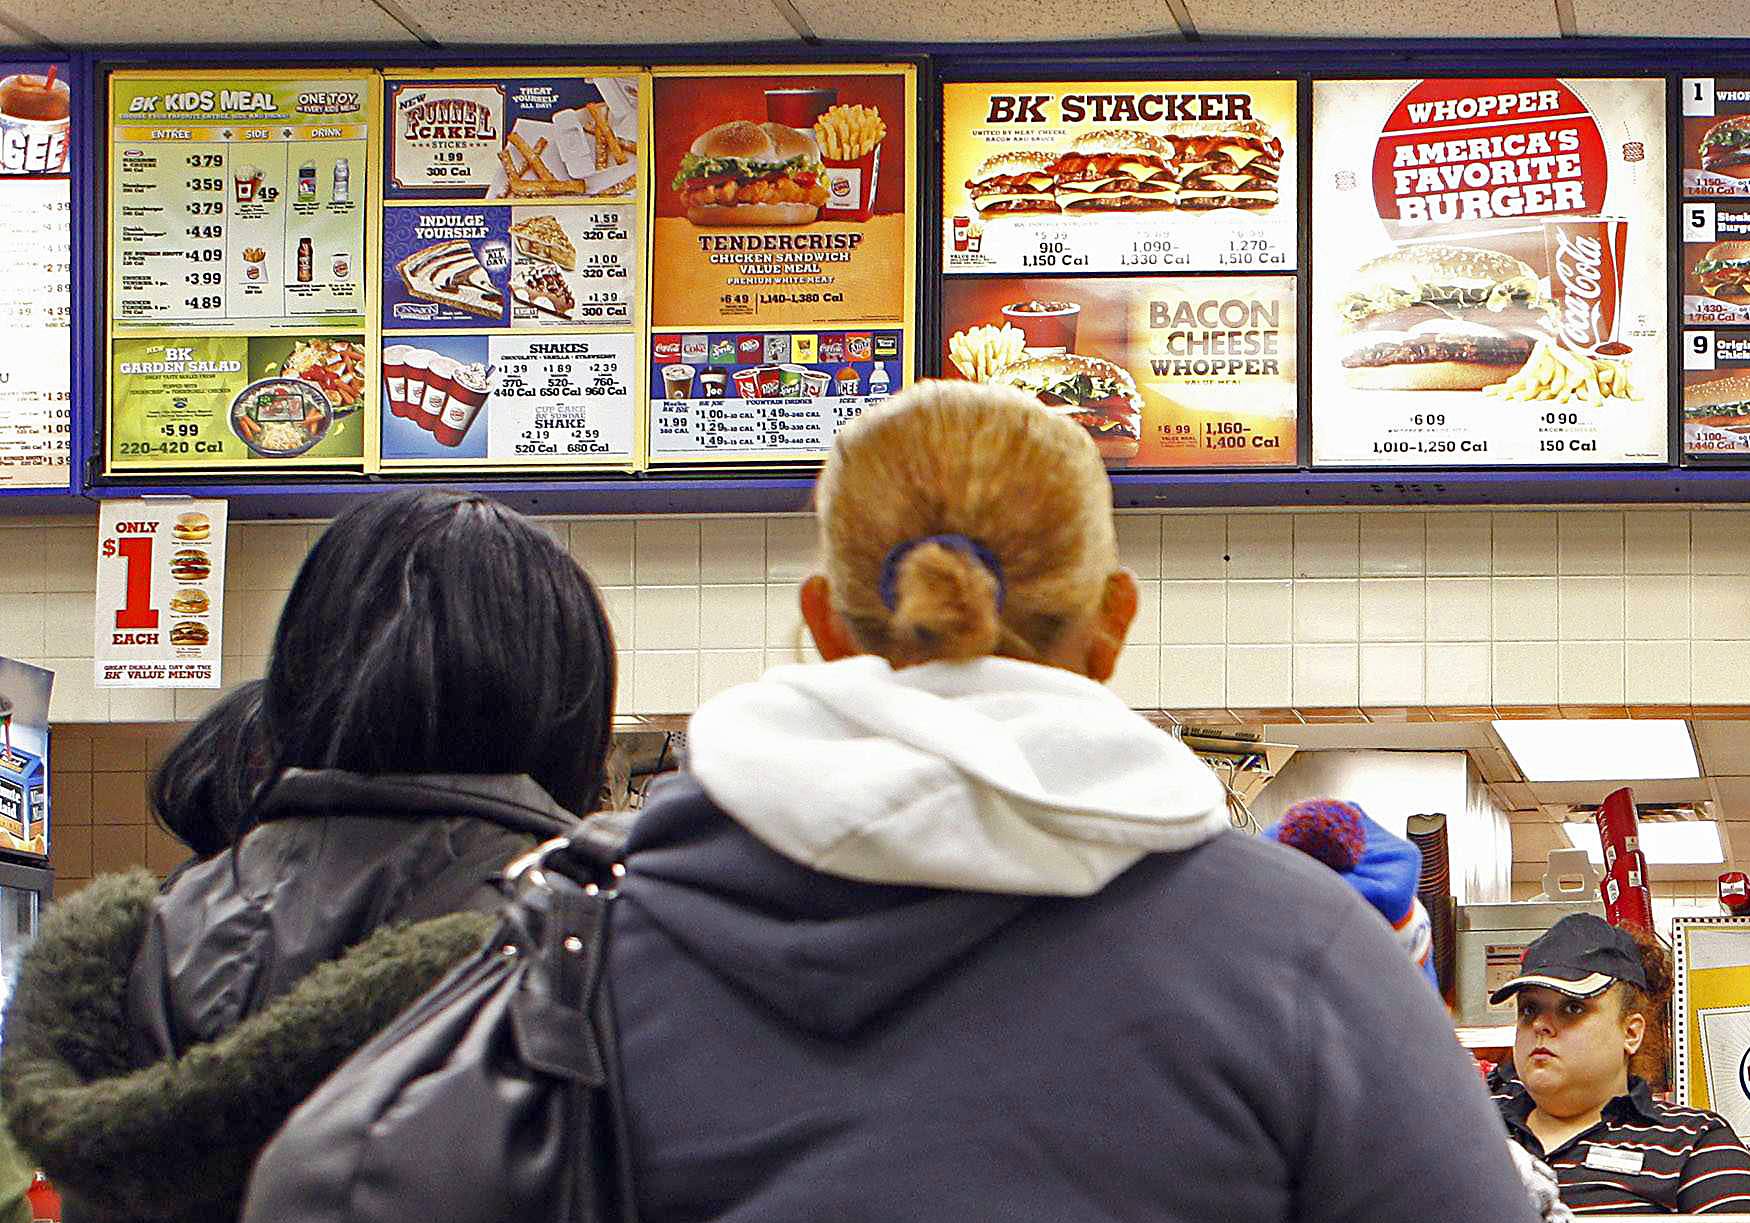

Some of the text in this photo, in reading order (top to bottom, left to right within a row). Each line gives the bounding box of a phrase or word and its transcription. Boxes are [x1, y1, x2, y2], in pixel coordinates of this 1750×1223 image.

[520, 87, 552, 95] TREAT
[1694, 83, 1703, 101] 1
[129, 90, 277, 112] BK KIDS MEAL
[299, 92, 356, 105] ONE TOY
[400, 94, 426, 109] NEW
[512, 95, 559, 103] YOURSELF
[986, 94, 1254, 123] BK STACKER
[1407, 91, 1561, 125] WHOPPER
[405, 98, 496, 140] FUNNEL
[246, 130, 268, 139] SIDE
[311, 128, 342, 137] DRINK
[419, 126, 477, 140] CAKE
[1392, 129, 1580, 168] AMERICA'S
[1394, 155, 1582, 195] FAVORITE
[1396, 181, 1586, 226] BURGER
[420, 215, 484, 227] INDULGE
[1691, 210, 1706, 228] 5
[415, 227, 489, 239] YOURSELF
[582, 230, 627, 240] 320 Cal
[699, 233, 862, 250] TENDERCRISP
[487, 251, 504, 260] ALL
[710, 252, 849, 263] CHICKEN SANDWICH
[1022, 255, 1089, 267] 1,150 Cal
[1163, 254, 1190, 265] Cal
[1258, 252, 1285, 264] Cal
[739, 263, 820, 274] VALUE MEAL
[1149, 299, 1280, 328] BACON
[529, 343, 589, 353] SHAKES
[1166, 330, 1279, 356] CHEESE
[1693, 336, 1708, 354] 9
[166, 348, 192, 360] BK
[120, 361, 240, 374] GARDEN SALAD
[1150, 359, 1280, 376] WHOPPER
[706, 383, 723, 396] Joe
[535, 419, 585, 429] SHAKE
[195, 441, 223, 453] Cal
[1206, 436, 1280, 449] 1,400 Cal
[1461, 441, 1488, 452] Cal
[1540, 440, 1596, 451] 150 Cal
[115, 522, 160, 533] ONLY
[102, 537, 159, 629] $1
[112, 633, 160, 645] EACH
[104, 671, 212, 680] BK VALUE MENUS
